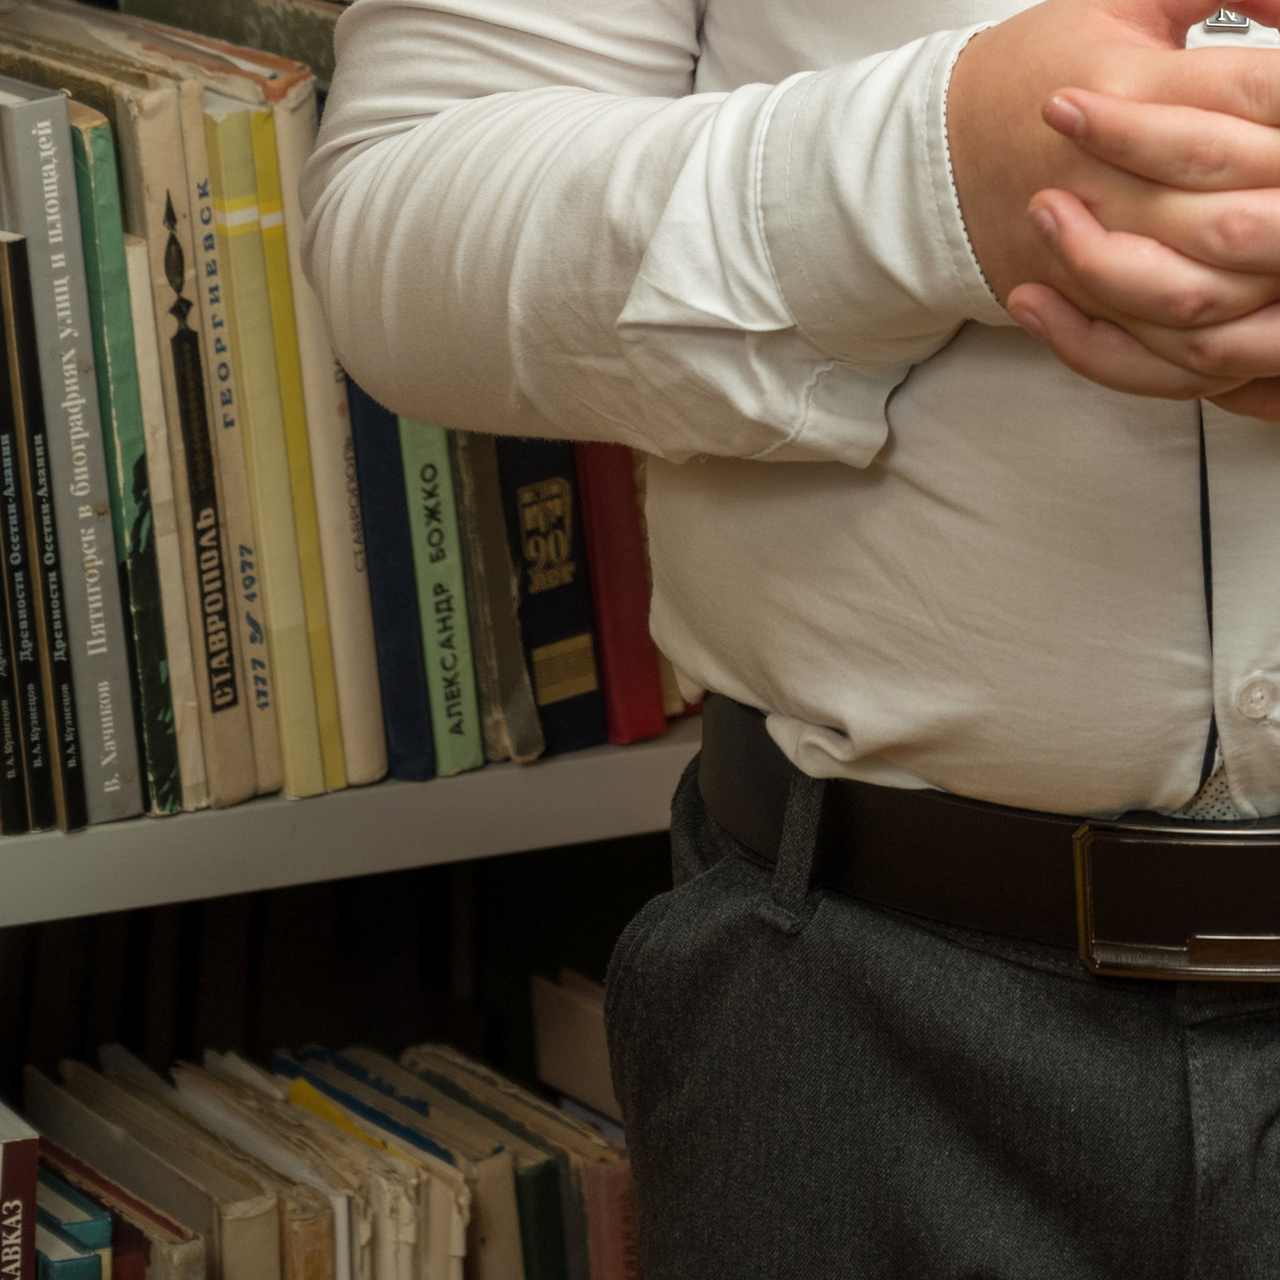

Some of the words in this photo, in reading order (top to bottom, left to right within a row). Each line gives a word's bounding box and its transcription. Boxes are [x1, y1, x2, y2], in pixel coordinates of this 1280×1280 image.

[31, 119, 63, 245] площадей
[50, 251, 66, 268] и
[197, 179, 235, 429] ГЕОРГИЕВСК
[52, 274, 79, 339] улиц
[60, 347, 89, 496] биографиях
[33, 433, 56, 565] Осетии-Алании
[78, 505, 92, 517] в
[419, 462, 446, 563] БОЖКО
[14, 571, 33, 660] Древности
[47, 571, 69, 662] Древности
[80, 527, 106, 654] Пятигорск
[197, 507, 234, 706] СТАВРОПОЛЬ
[237, 543, 259, 603] 1977
[249, 657, 269, 711] 1777
[432, 582, 465, 735] АЛЕКСАНДР
[97, 680, 116, 766] Хачиков
[103, 773, 120, 792] В.
